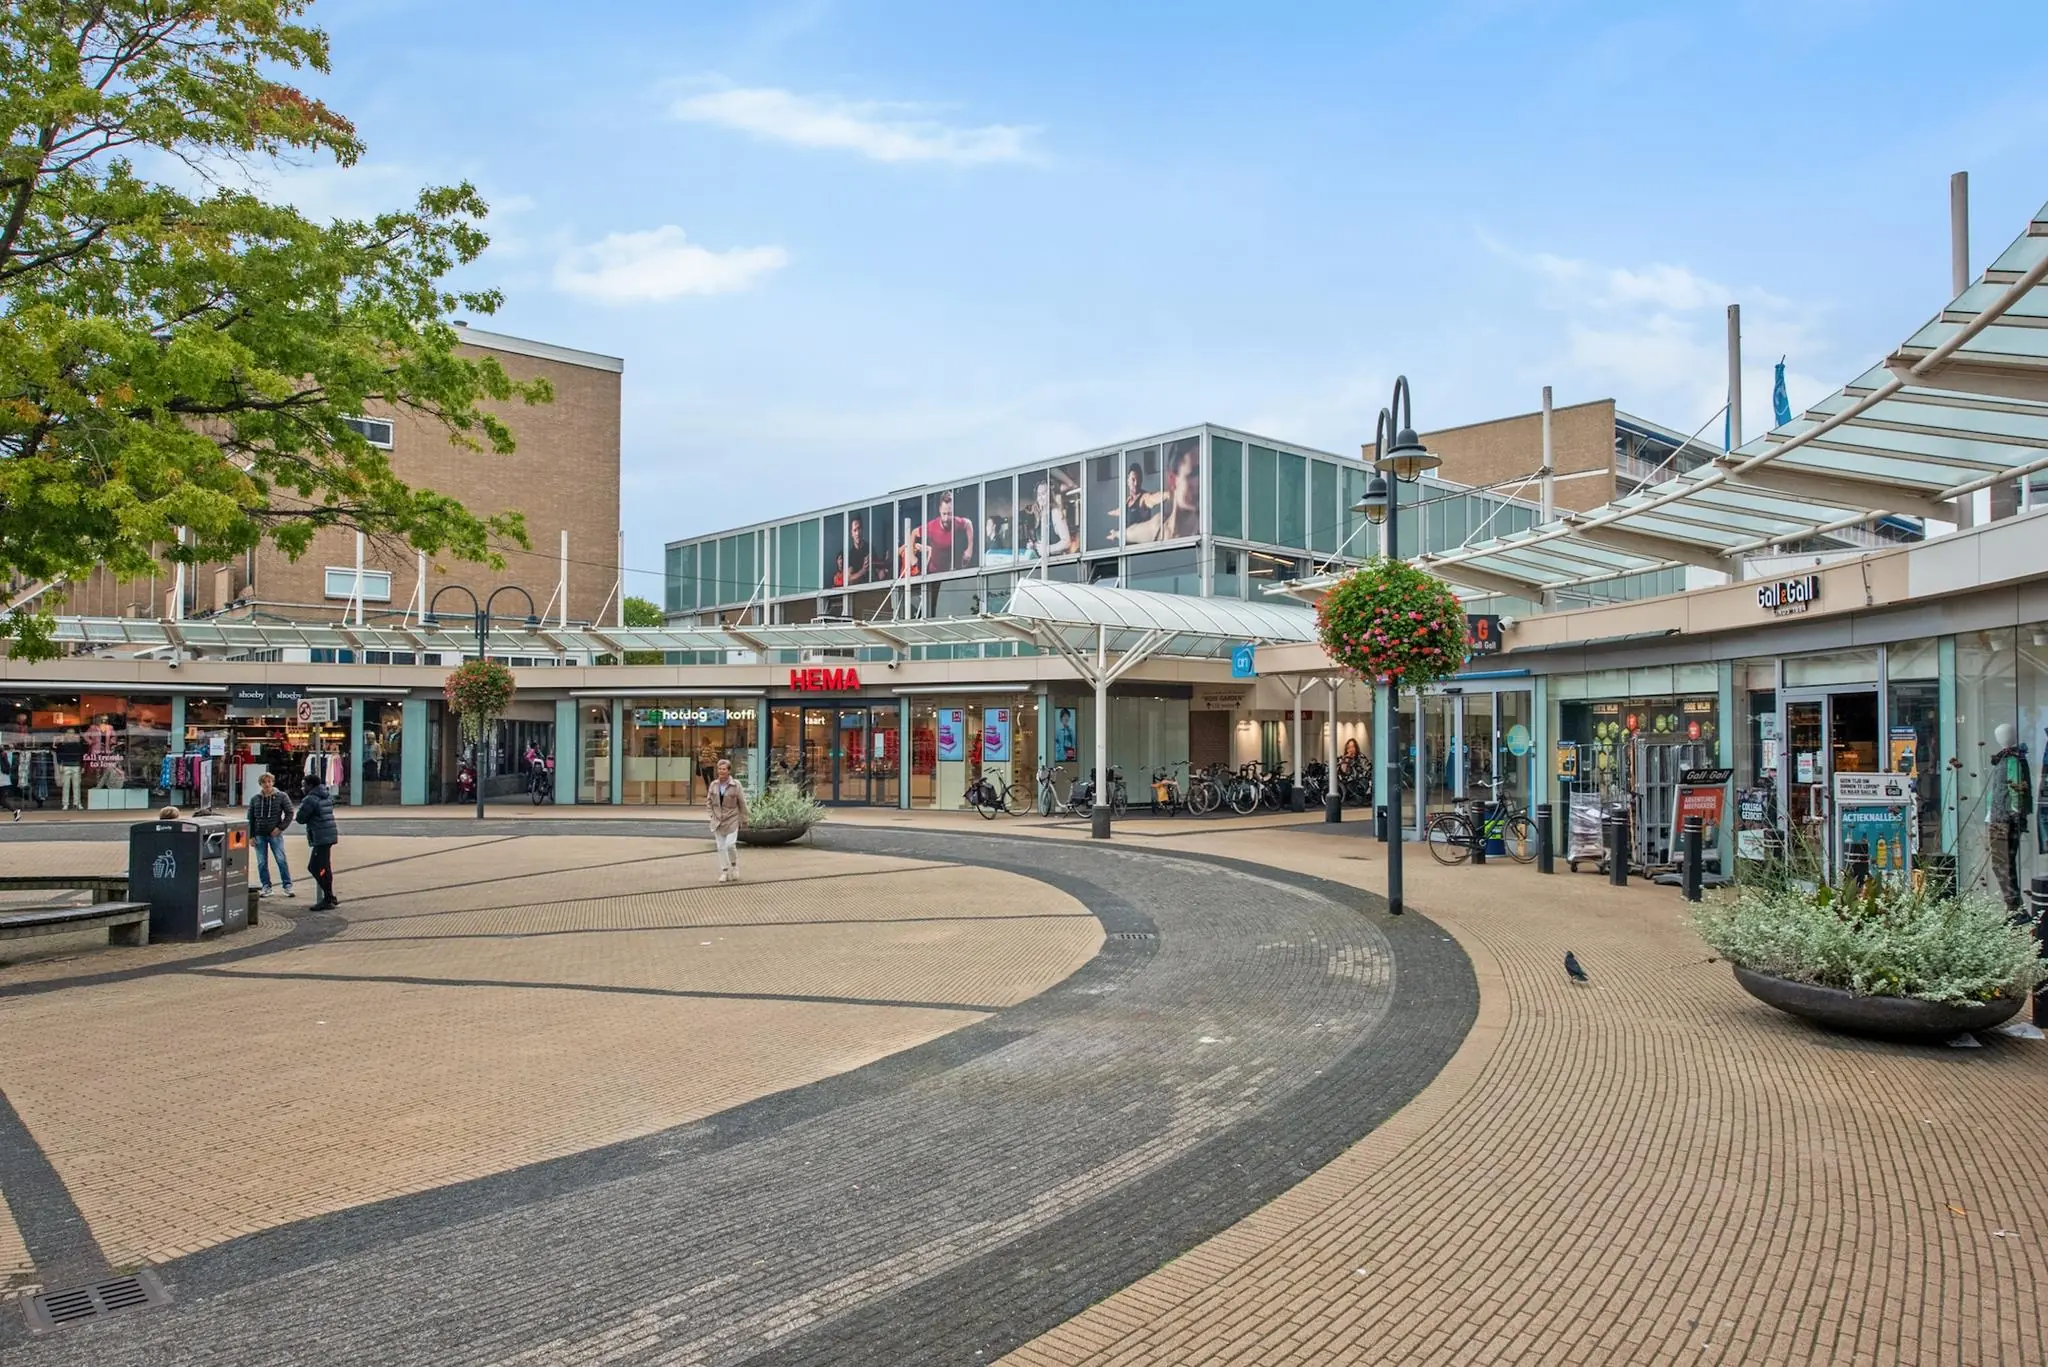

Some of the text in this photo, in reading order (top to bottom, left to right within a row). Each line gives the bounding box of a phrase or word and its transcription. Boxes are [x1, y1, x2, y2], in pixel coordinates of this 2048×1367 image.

[1477, 618, 1489, 641] G
[789, 667, 860, 692] HEMA
[238, 690, 265, 700] shoeby
[276, 691, 302, 701] shoeby
[662, 708, 757, 722] hotdog koffi
[805, 715, 826, 725] taart
[1686, 770, 1729, 780] Gall Gall
